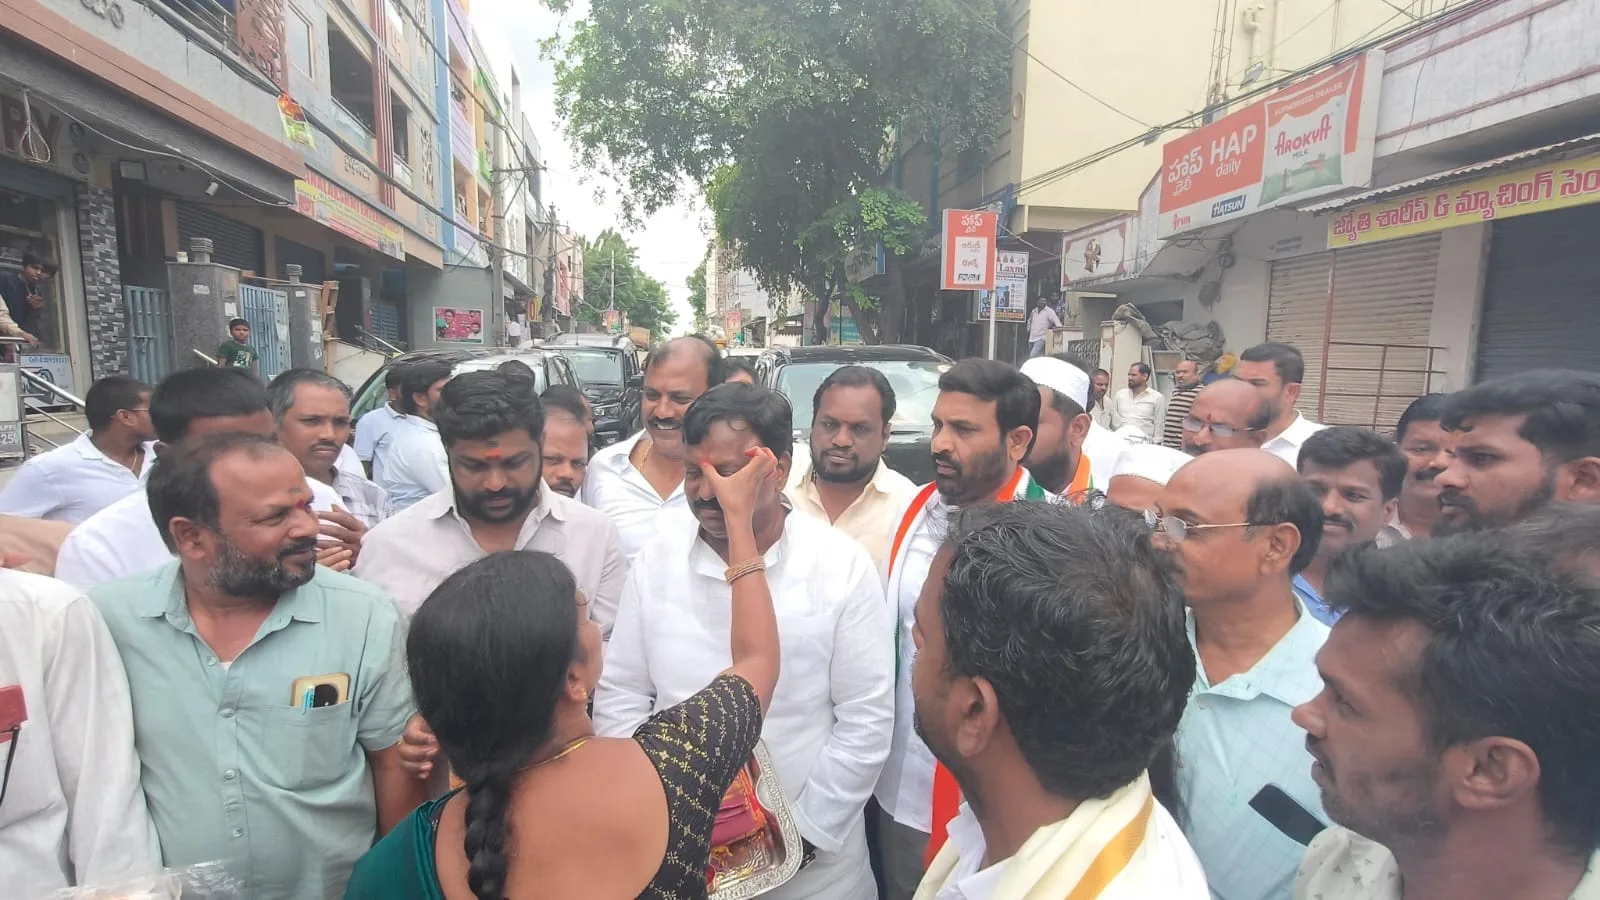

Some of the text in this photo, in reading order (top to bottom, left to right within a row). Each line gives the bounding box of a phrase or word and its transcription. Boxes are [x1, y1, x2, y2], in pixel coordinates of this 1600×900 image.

[1209, 124, 1258, 166] HAP
[1215, 158, 1242, 178] daily
[1211, 194, 1247, 219] HATSUN
